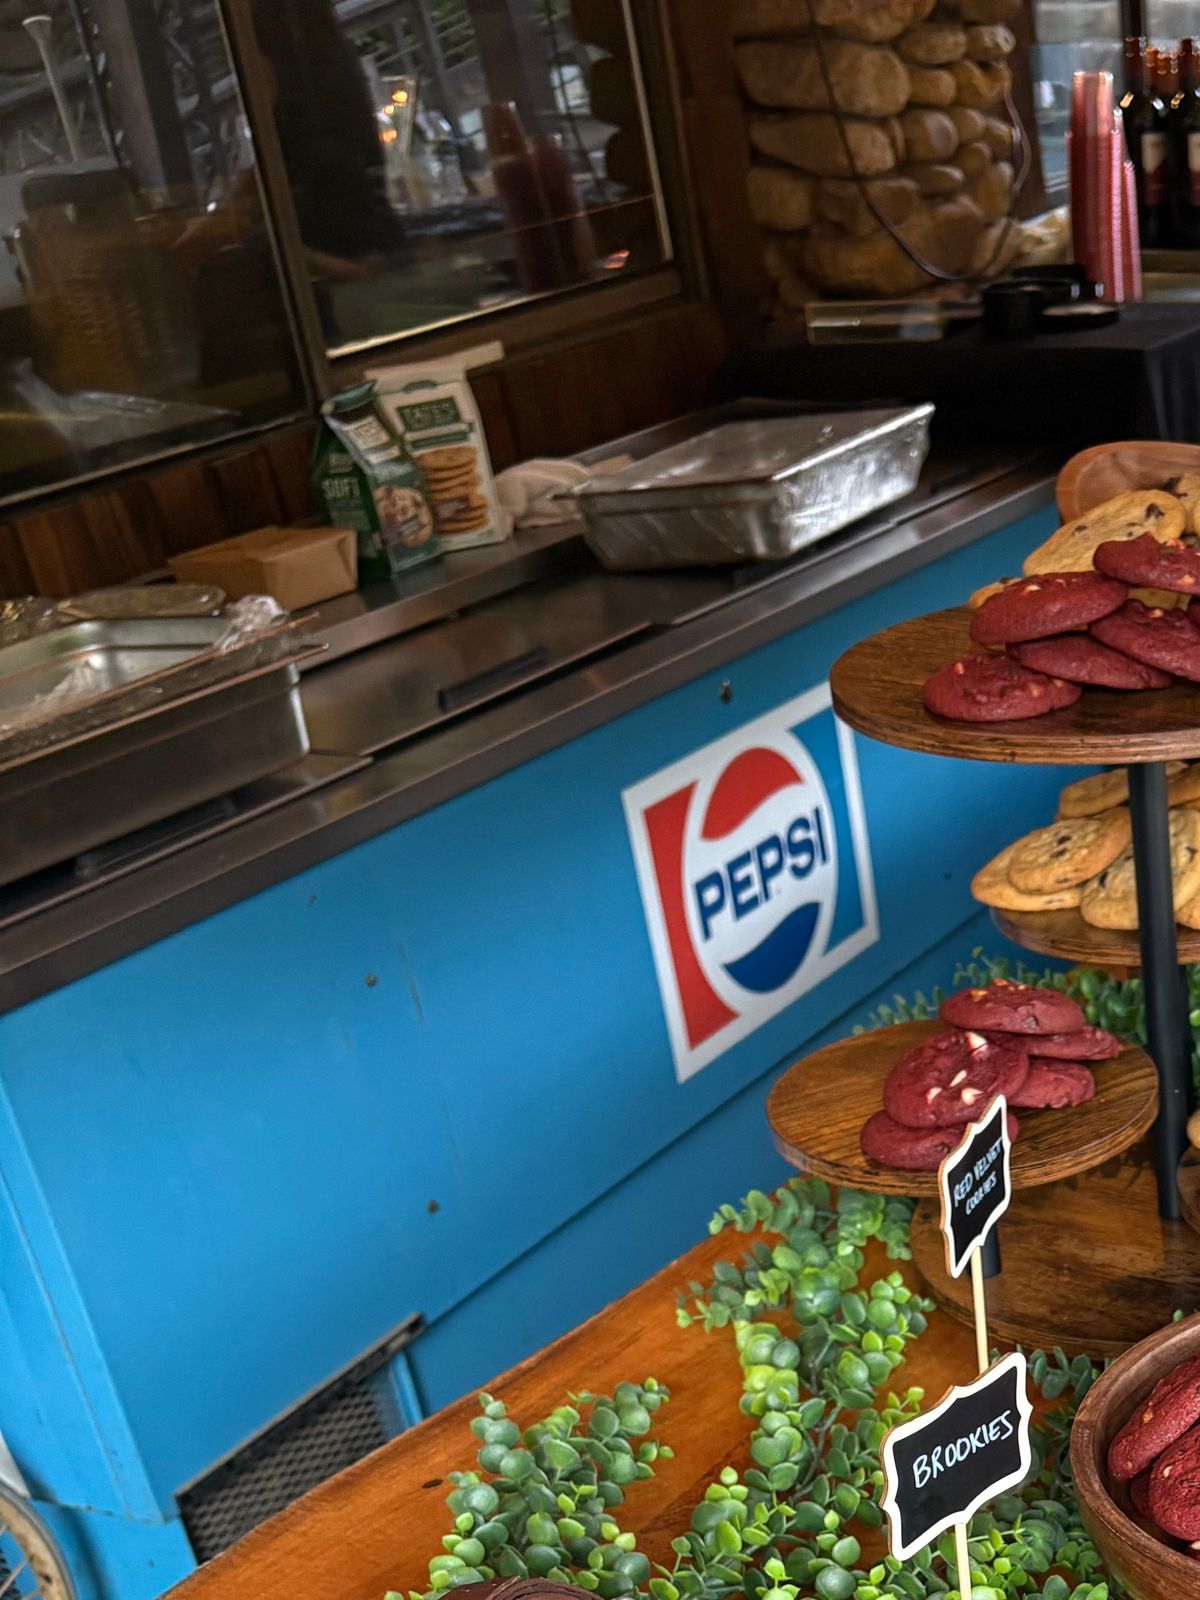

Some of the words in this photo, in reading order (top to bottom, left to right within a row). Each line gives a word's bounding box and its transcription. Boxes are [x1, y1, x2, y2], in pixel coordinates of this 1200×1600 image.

[692, 805, 828, 941] PEPSI
[953, 1172, 973, 1208] RED
[973, 1136, 1002, 1182] VELVET
[965, 1170, 998, 1216] COOKIES
[912, 1410, 1014, 1489] BROOKIES
